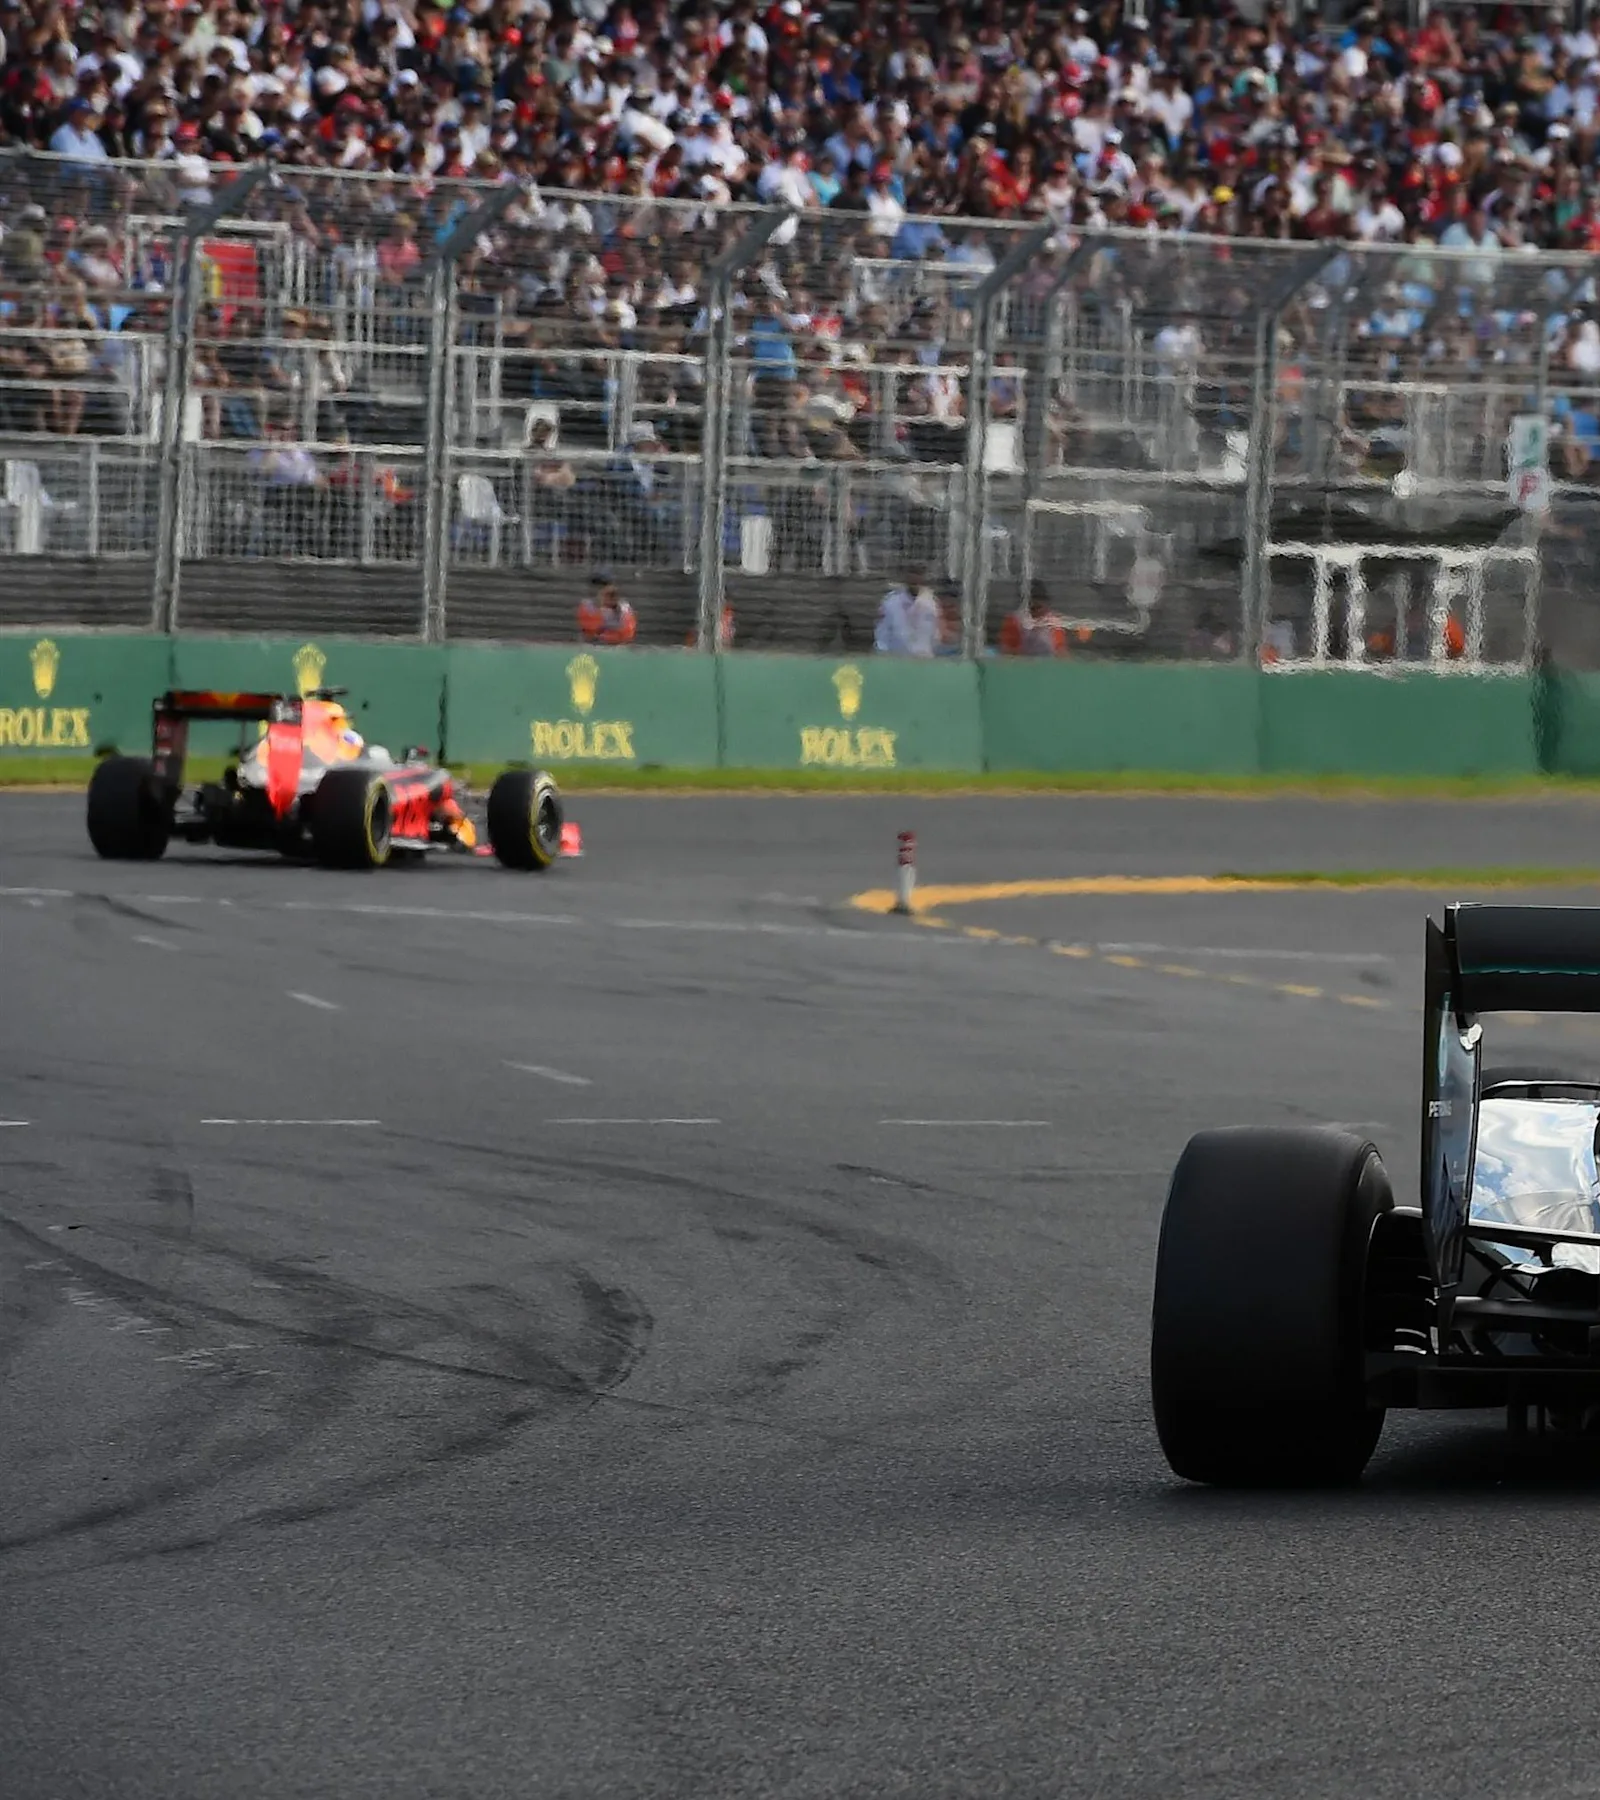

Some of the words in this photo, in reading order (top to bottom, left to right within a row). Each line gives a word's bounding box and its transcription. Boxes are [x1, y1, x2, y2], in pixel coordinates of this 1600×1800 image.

[0, 708, 89, 747] ROLEX
[531, 721, 635, 758] ROLEX
[802, 729, 897, 767] ROLEX
